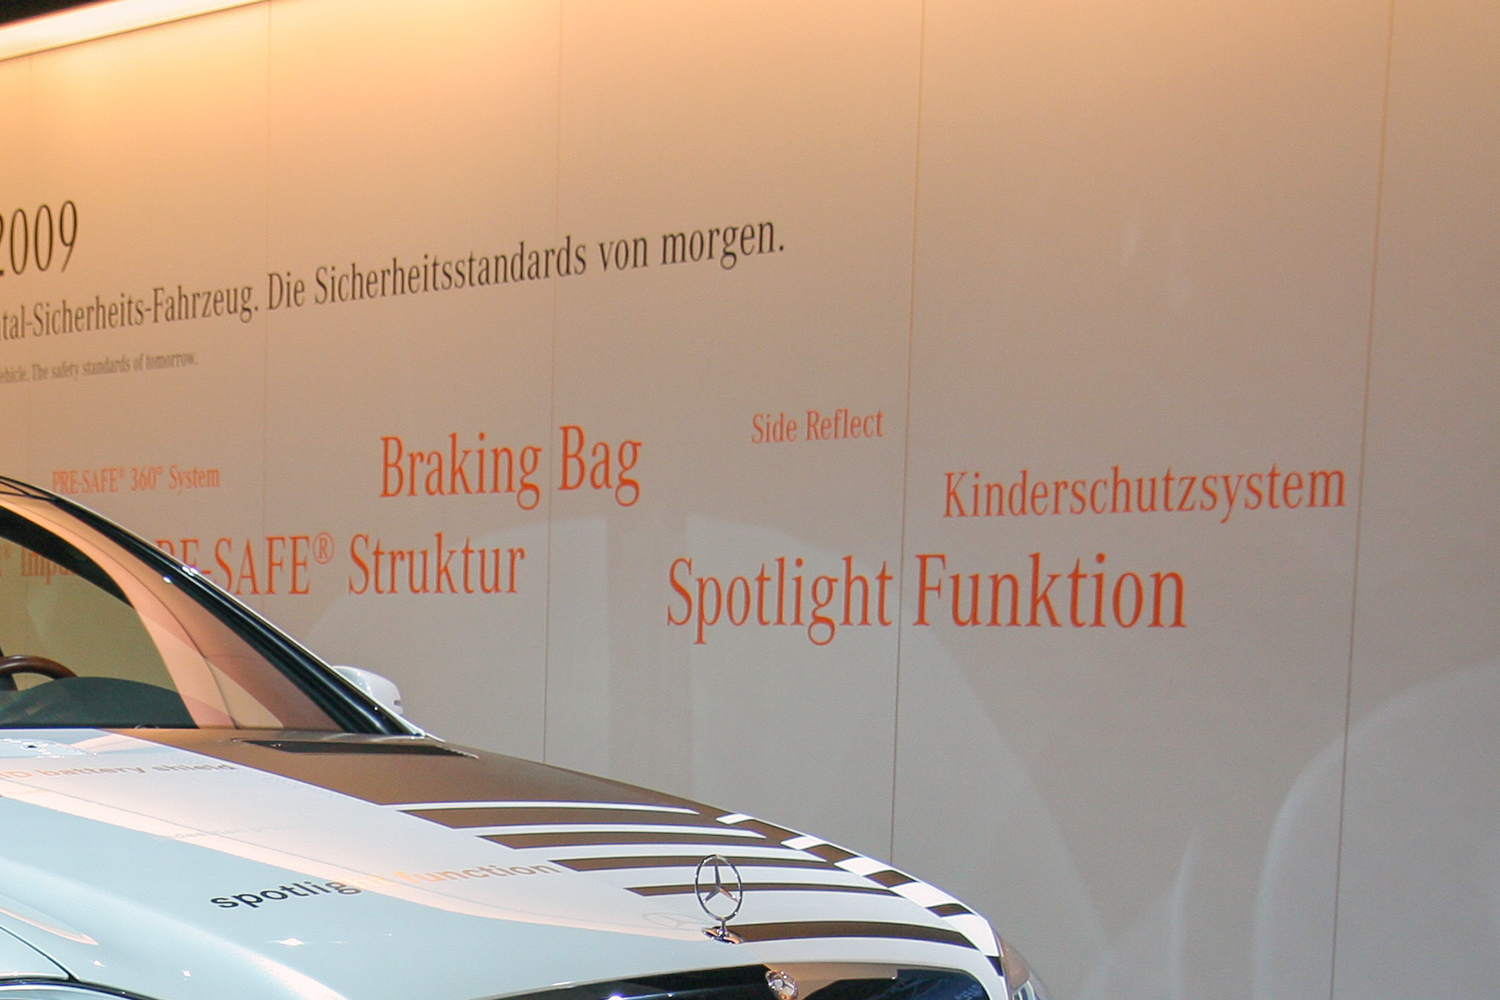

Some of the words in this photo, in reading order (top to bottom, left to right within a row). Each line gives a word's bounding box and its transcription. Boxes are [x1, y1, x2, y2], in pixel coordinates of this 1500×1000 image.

[267, 271, 306, 311] Die
[314, 235, 587, 305] Sicherheitsstandards
[598, 237, 649, 271] von
[660, 220, 785, 270] morgen.
[32, 362, 49, 381] The
[51, 361, 80, 381] safety
[82, 353, 131, 376] standards
[133, 353, 144, 372] of
[751, 413, 797, 444] Side
[805, 409, 884, 441] Reflect
[169, 463, 221, 495] System
[379, 432, 542, 510] Braking
[558, 425, 642, 507] Bag
[942, 463, 1346, 525] Kinderschutzsystem
[348, 532, 525, 594] Struktur
[667, 555, 893, 645] Spotlight
[912, 553, 1187, 628] Funktion
[34, 766, 146, 777] battery
[395, 864, 562, 885] function
